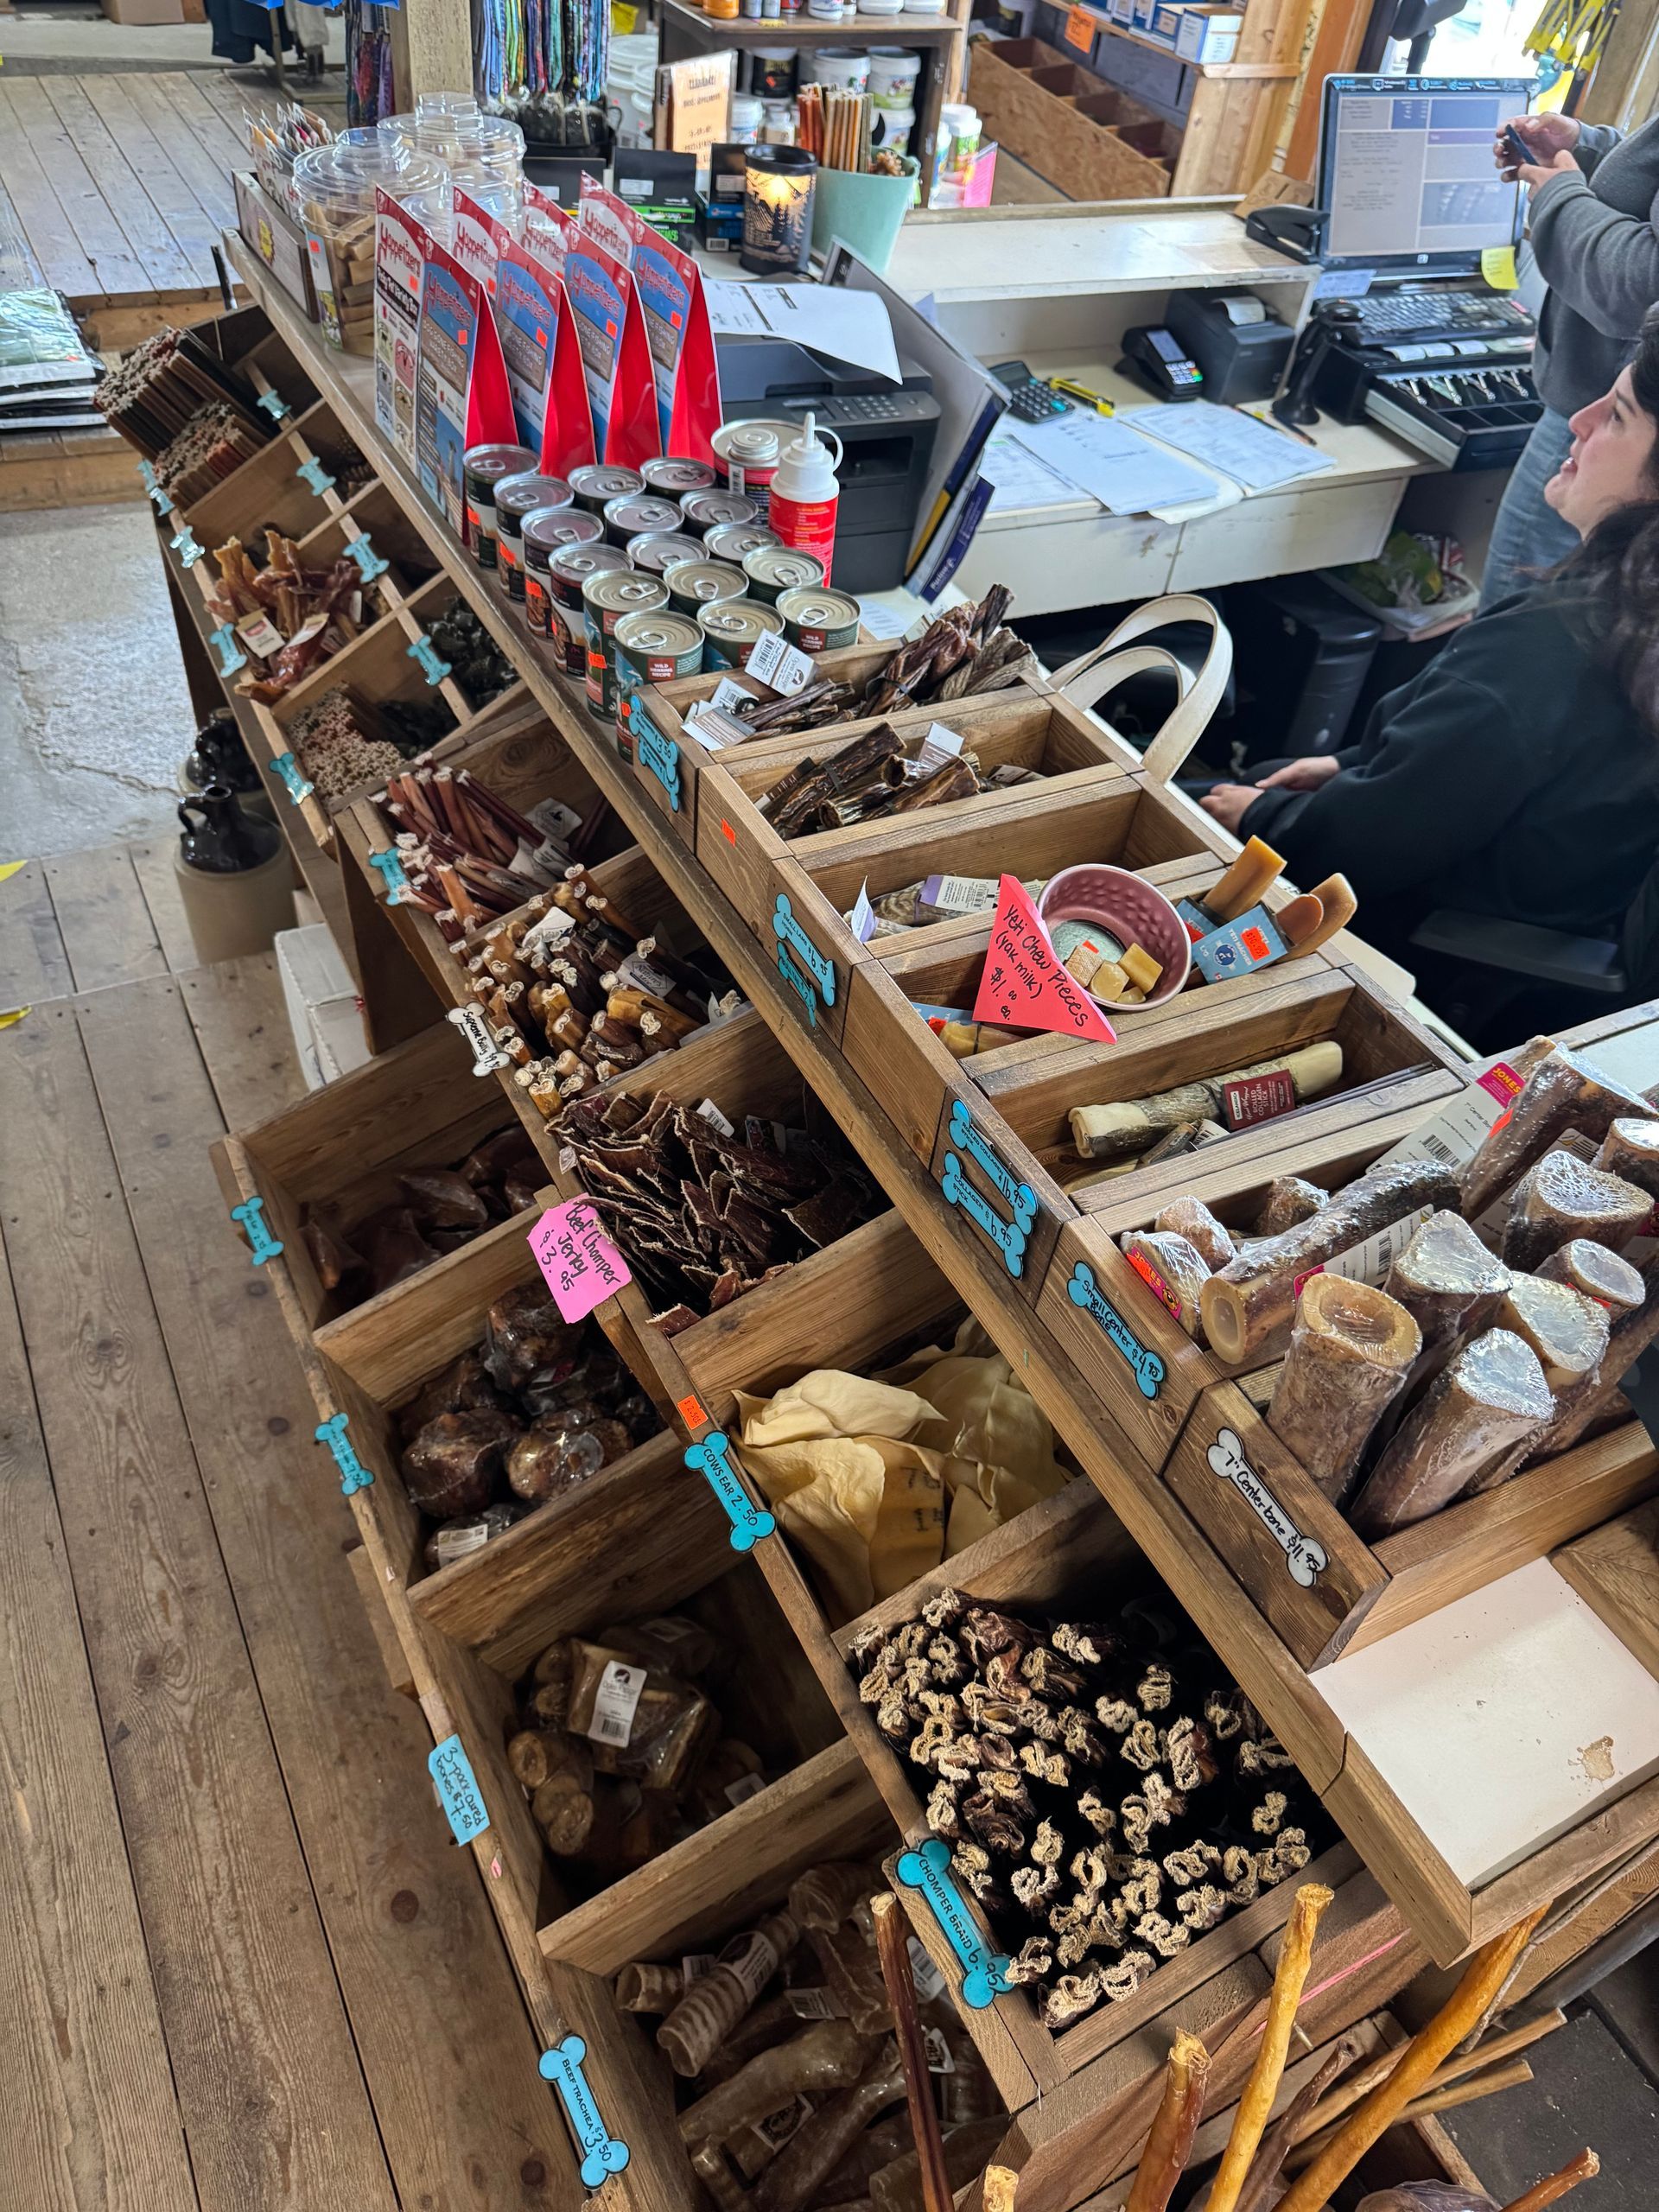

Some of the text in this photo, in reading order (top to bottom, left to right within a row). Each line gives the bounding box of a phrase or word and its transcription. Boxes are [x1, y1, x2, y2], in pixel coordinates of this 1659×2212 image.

[378, 222, 421, 277] Yappetizers
[569, 263, 620, 319] Yappetizers
[636, 254, 685, 309] Yappetizers
[783, 912, 797, 932] SMALL
[1228, 927, 1238, 943] YETI
[995, 931, 1042, 999] (yak milk)
[1003, 905, 1089, 1027] Yeti Chew Pieces
[463, 1011, 482, 1039] Supreme
[1001, 1005, 1011, 1020] ea.
[1255, 1084, 1264, 1116] COLLAGEN
[1492, 1067, 1522, 1093] JONES
[960, 1127, 974, 1147] STICK
[962, 1122, 979, 1149] ROLLED
[977, 1144, 1003, 1178] COLLAGEN
[952, 1183, 969, 1204] STICK
[954, 1173, 983, 1211] COLLAGEN
[558, 1232, 588, 1278] Jerky
[566, 1205, 621, 1285] Beef Chomper
[1135, 1252, 1161, 1287] JOES
[1082, 1279, 1105, 1318] Small
[1105, 1310, 1132, 1348] Center
[1090, 1303, 1111, 1332] Bone
[703, 1448, 758, 1526] COWS EAR 2.50
[1236, 1471, 1264, 1509] Center
[1262, 1505, 1286, 1536] bone
[436, 1756, 454, 1796] bones
[918, 1859, 1005, 1988] CHOMPER BRAID 6.95
[563, 2058, 575, 2083] BEEF
[573, 2085, 594, 2131] TRACHEA
